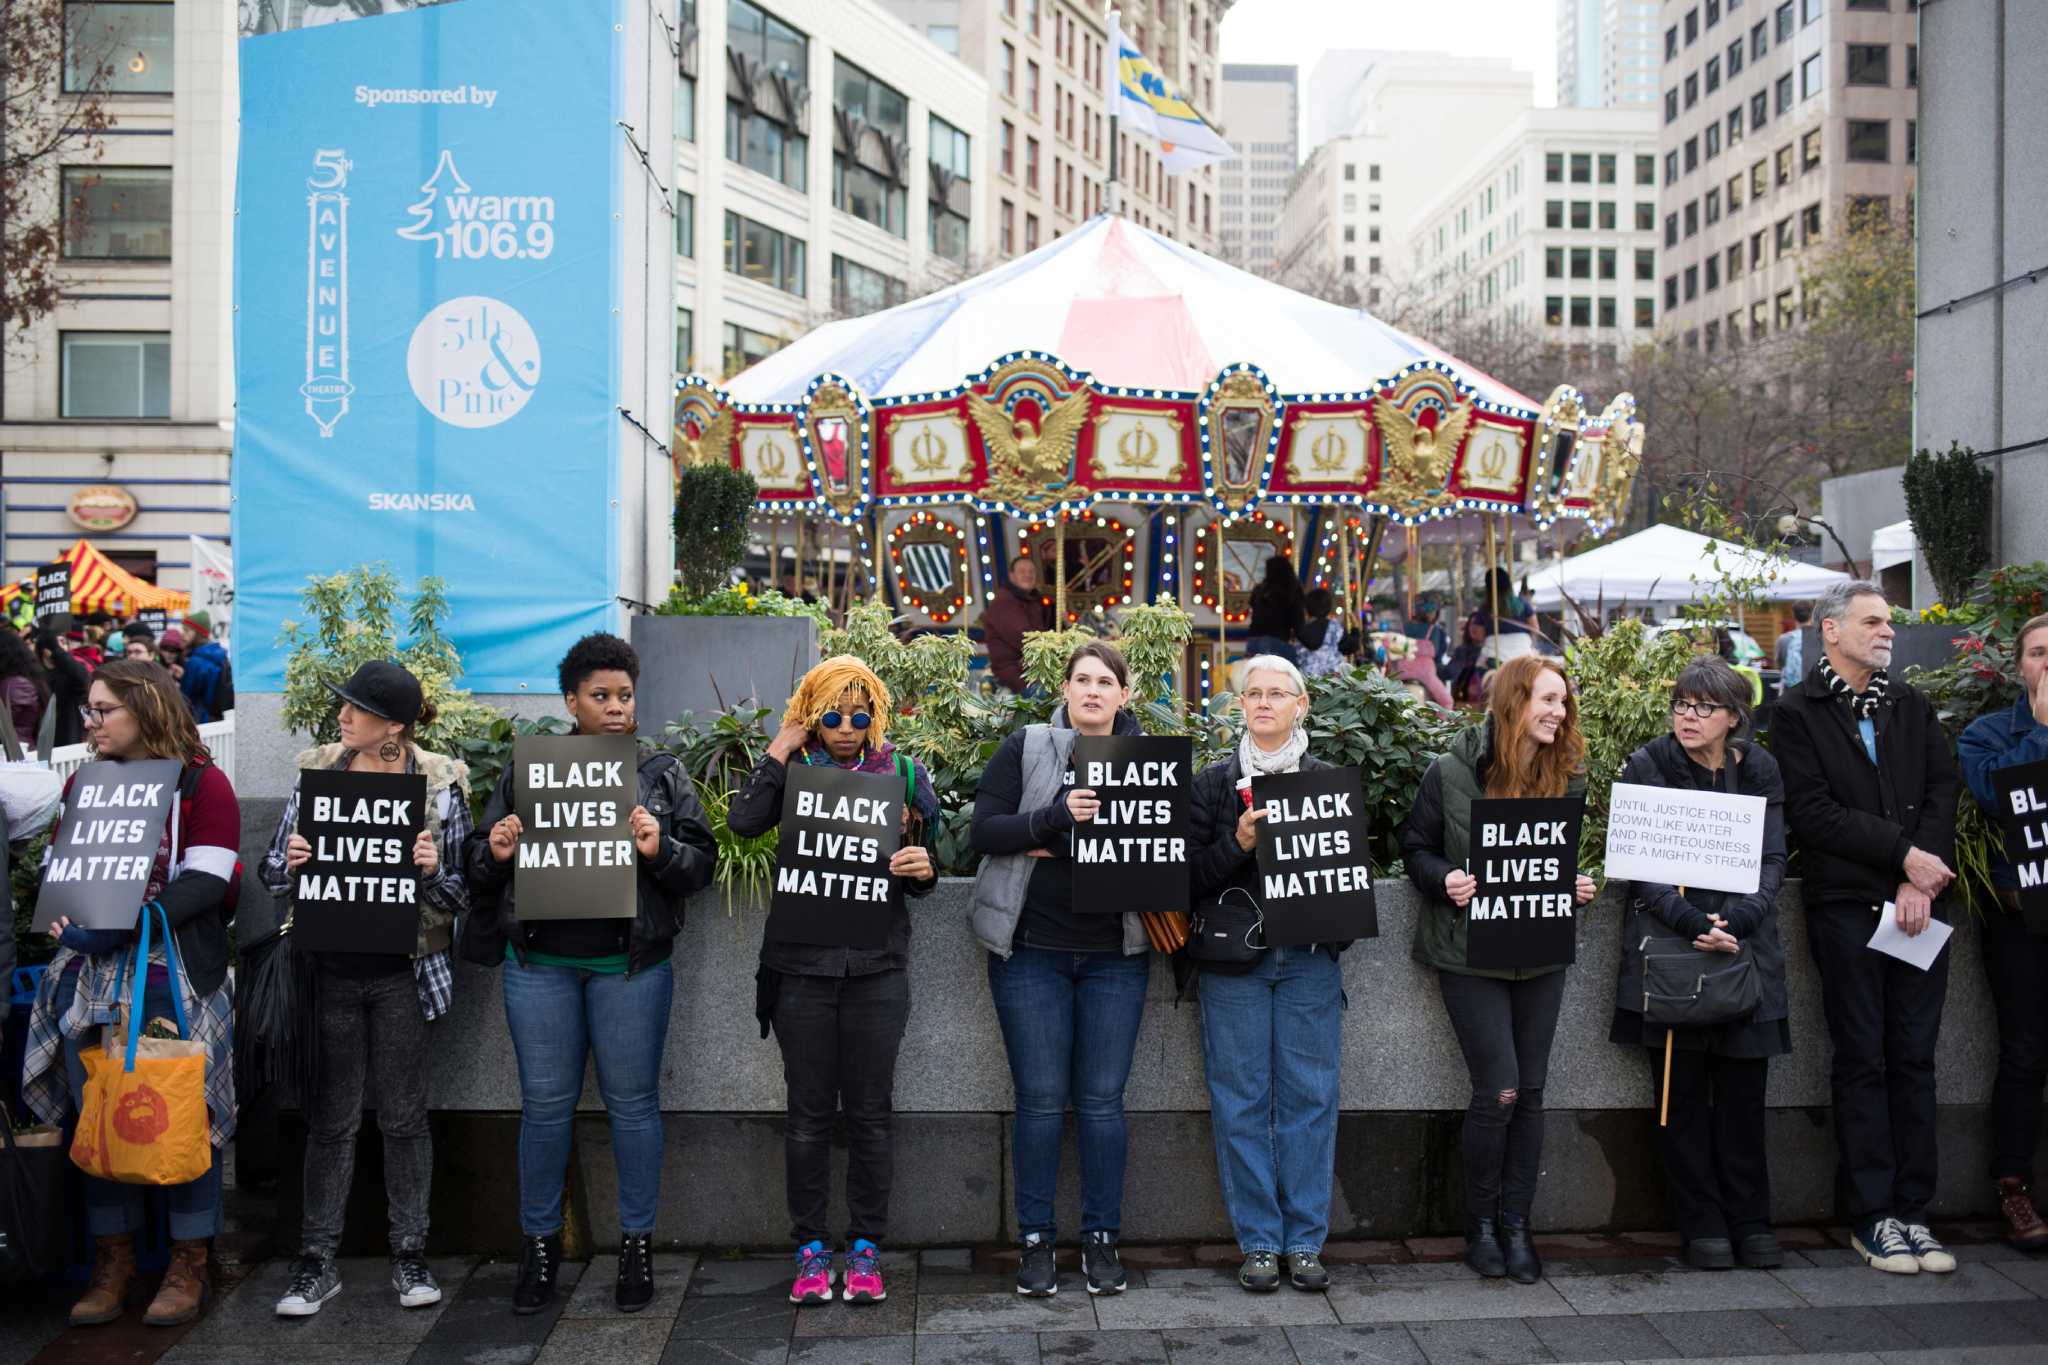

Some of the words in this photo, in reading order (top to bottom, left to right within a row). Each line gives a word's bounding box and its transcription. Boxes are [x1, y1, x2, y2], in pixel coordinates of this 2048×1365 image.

[355, 85, 467, 108] Sponsored
[471, 85, 497, 108] by
[445, 196, 555, 221] warm
[445, 221, 555, 260] 106.9
[319, 207, 337, 368] AVENUE
[307, 384, 347, 394] THEATRE
[438, 378, 515, 414] Pine
[368, 492, 475, 512] SKANSKA
[38, 571, 68, 588] BLACK
[38, 586, 65, 602] LIVES
[528, 761, 623, 789] BLACK
[1087, 761, 1178, 787] BLACK
[77, 783, 164, 809] BLACK
[796, 790, 890, 826] BLACK
[1266, 792, 1353, 824] BLACK
[313, 796, 411, 826] BLACK
[534, 801, 617, 828] LIVES
[1093, 800, 1171, 825] LIVES
[1614, 800, 1649, 813] UNTIL
[1653, 803, 1707, 819] JUSTICE
[1709, 809, 1751, 824] ROLLS
[70, 819, 147, 845] LIVES
[1482, 821, 1567, 847] BLACK
[1612, 813, 1650, 827] DOWN
[1655, 818, 1683, 832] LIKE
[1686, 822, 1732, 836] WATER
[317, 836, 402, 864] LIVES
[797, 830, 879, 864] LIVES
[1077, 837, 1186, 863] MATTER
[1275, 830, 1351, 861] LIVES
[1608, 843, 1636, 855] LIKE
[1639, 846, 1648, 857] A
[1651, 847, 1701, 863] MIGHTY
[1610, 828, 1637, 840] AND
[1641, 831, 1751, 854] RIGHTEOUSNESS
[519, 840, 633, 869] MATTER
[46, 855, 150, 883] MATTER
[1264, 865, 1370, 899] MATTER
[1486, 858, 1559, 883] LIVES
[298, 874, 416, 904] MATTER
[777, 866, 889, 902] MATTER
[1470, 893, 1572, 920] MATTER
